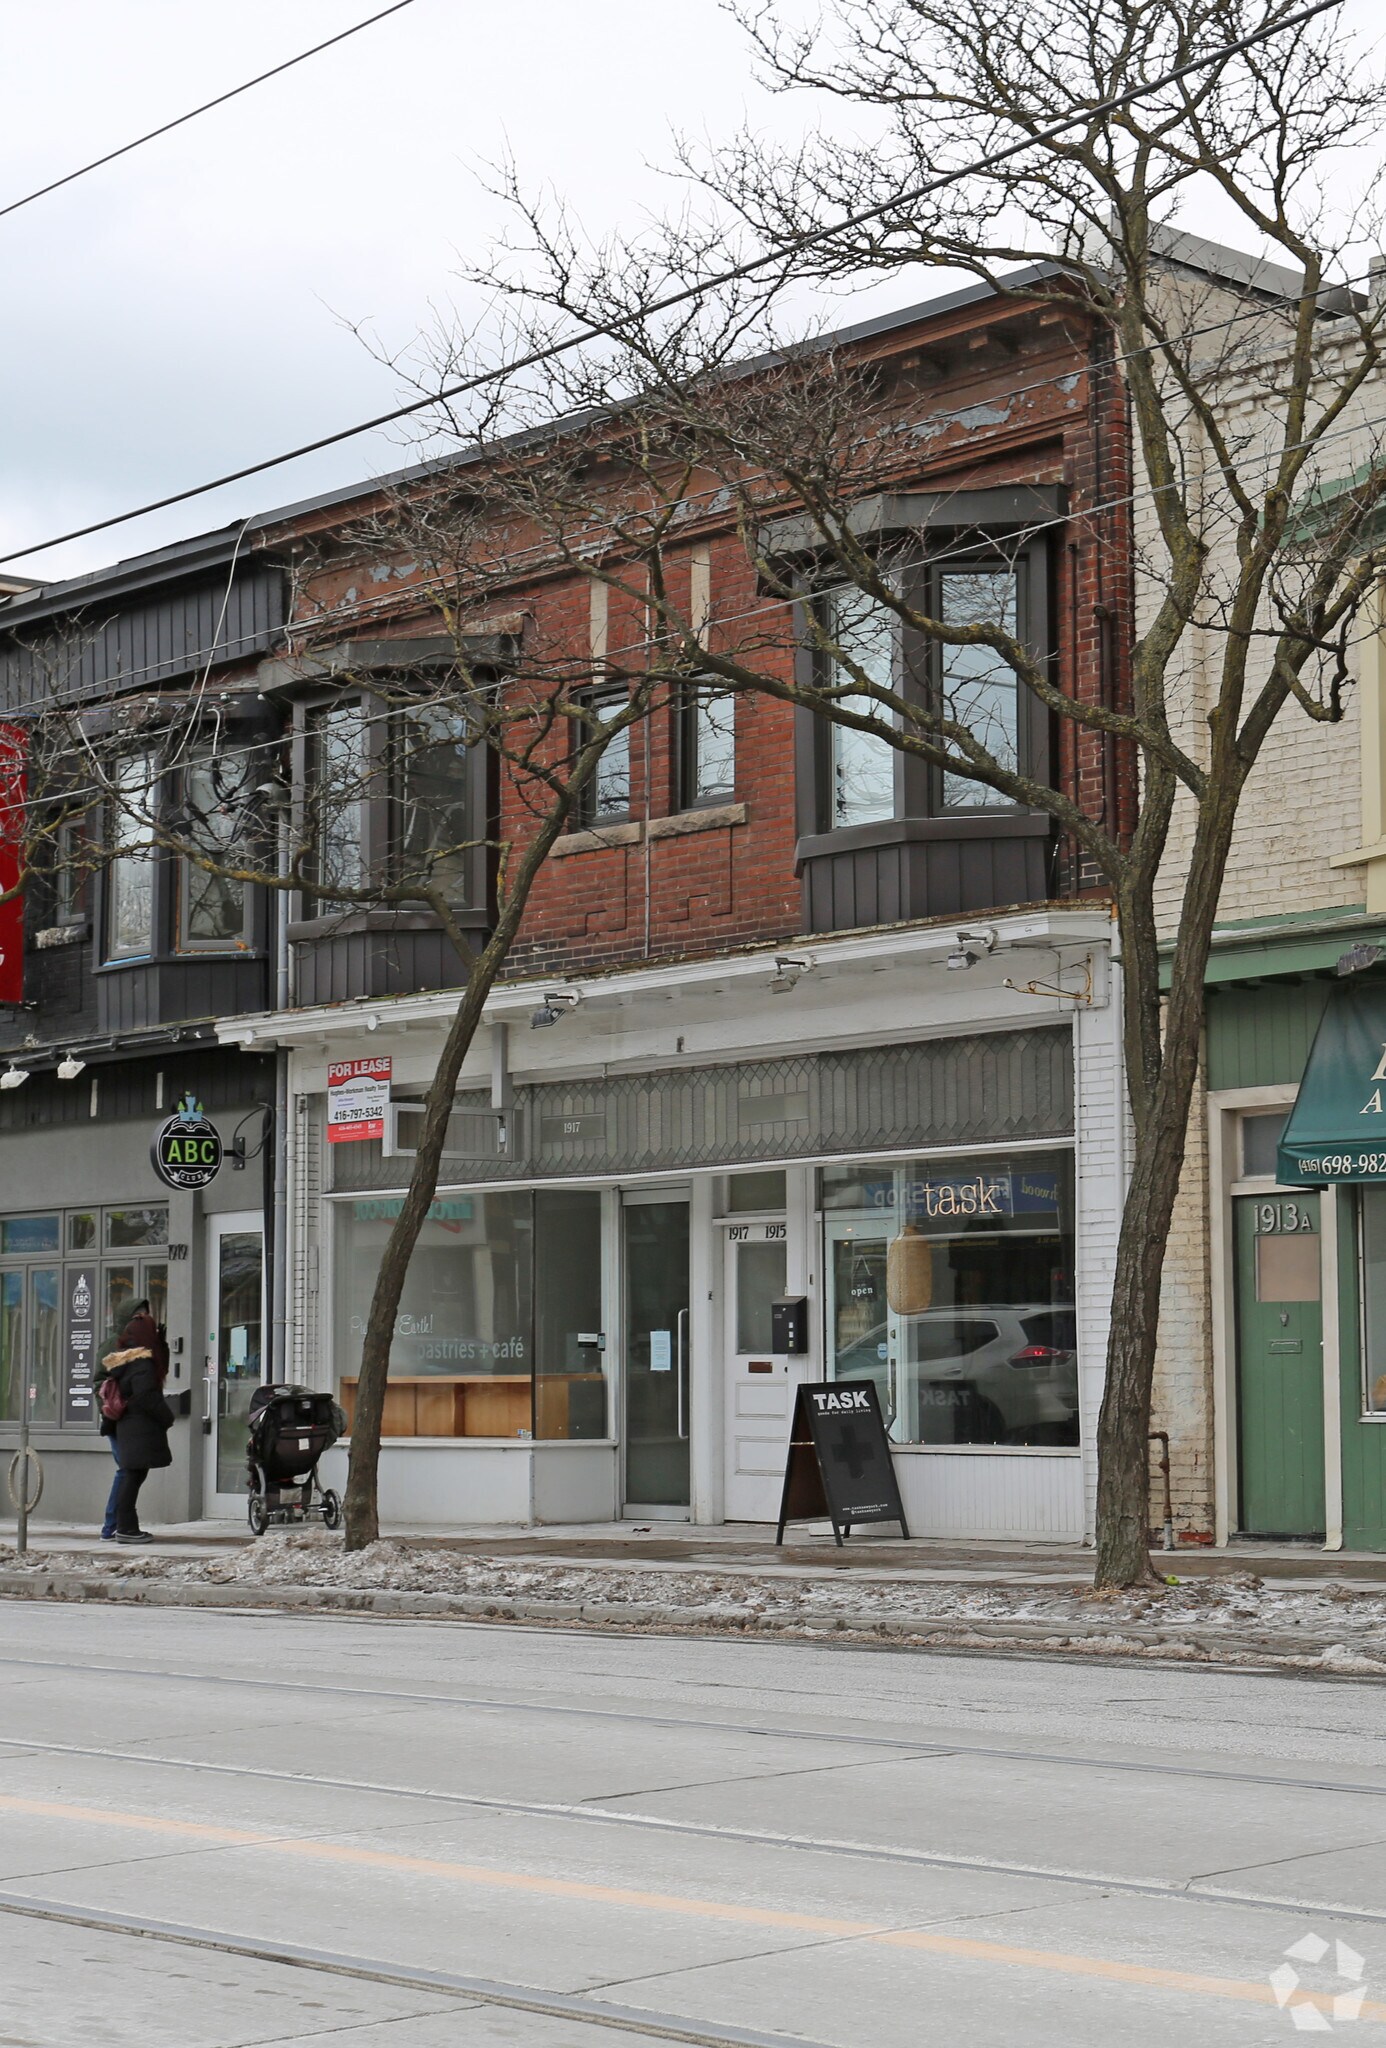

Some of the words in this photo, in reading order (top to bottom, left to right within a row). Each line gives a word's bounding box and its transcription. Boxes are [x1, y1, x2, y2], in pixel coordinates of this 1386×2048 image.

[329, 1063, 352, 1078] FOR
[354, 1058, 390, 1075] LEASE
[334, 1106, 383, 1121] 416-797-5342
[564, 1121, 580, 1133] 1917
[167, 1140, 214, 1163] ABC
[1298, 1158, 1320, 1175] (416)
[180, 1172, 202, 1180] CLUB
[923, 1176, 1003, 1217] task
[729, 1226, 749, 1240] 1917
[765, 1224, 787, 1239] 1915
[75, 1294, 89, 1306] ABC
[851, 1287, 873, 1297] open
[416, 1340, 475, 1360] pastries
[492, 1336, 524, 1359] café
[812, 1391, 870, 1410] TASK
